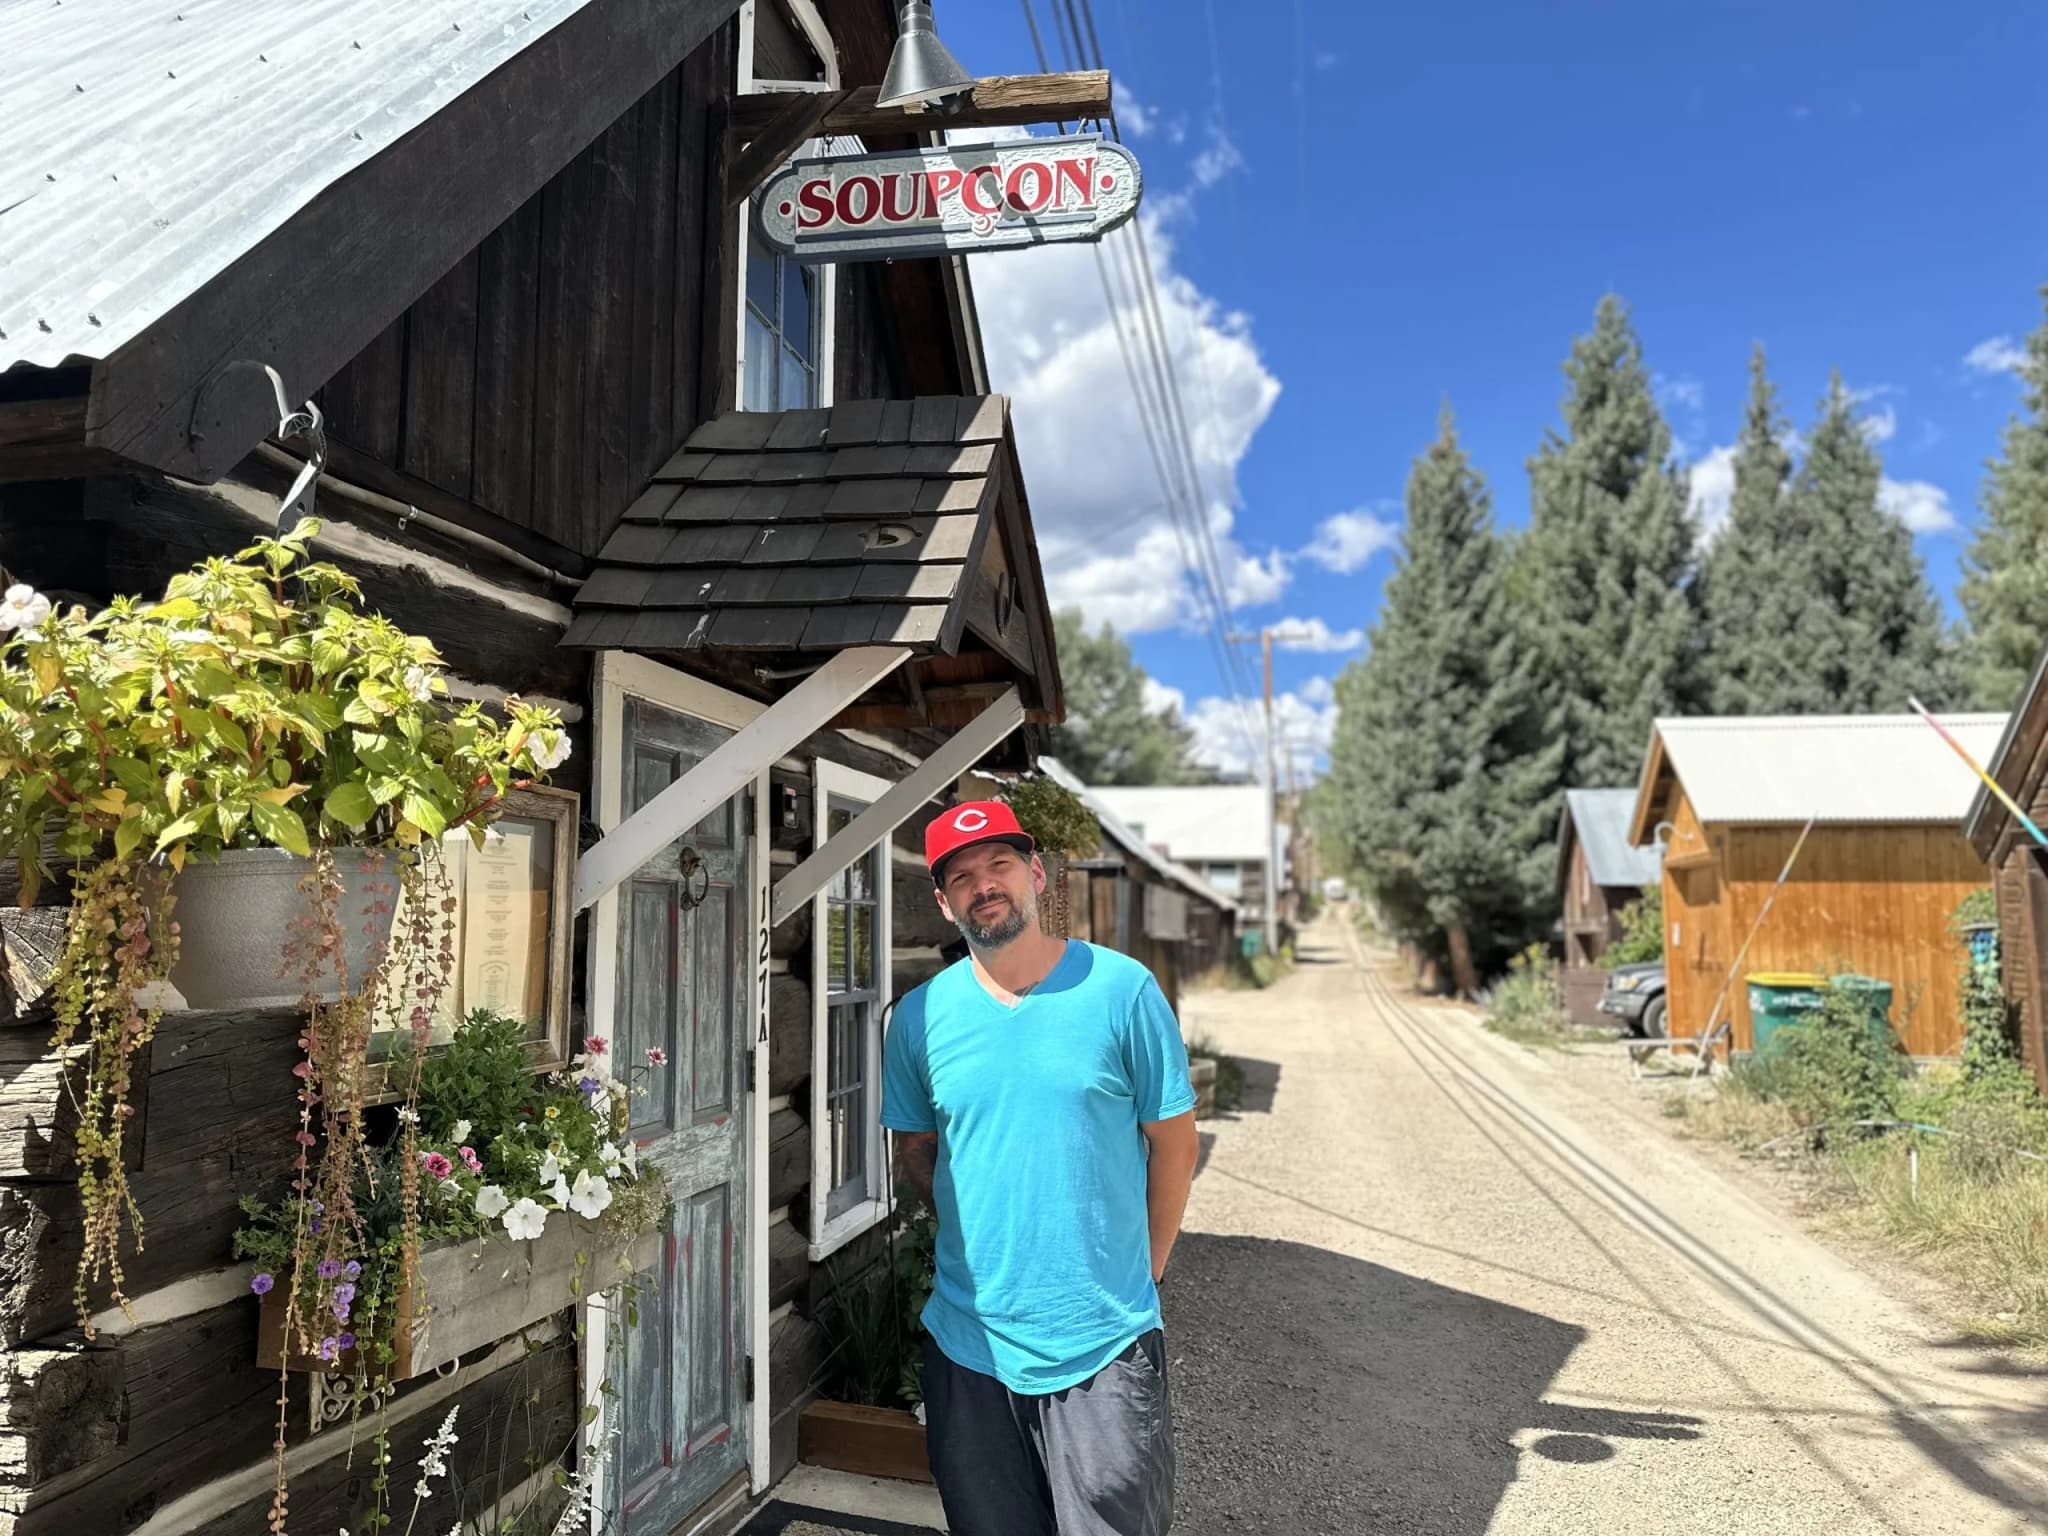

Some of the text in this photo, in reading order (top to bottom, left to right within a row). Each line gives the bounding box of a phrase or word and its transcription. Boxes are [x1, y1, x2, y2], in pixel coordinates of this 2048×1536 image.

[796, 157, 1098, 234] SOUPÇON
[954, 809, 988, 832] C
[758, 885, 769, 1043] 127A
